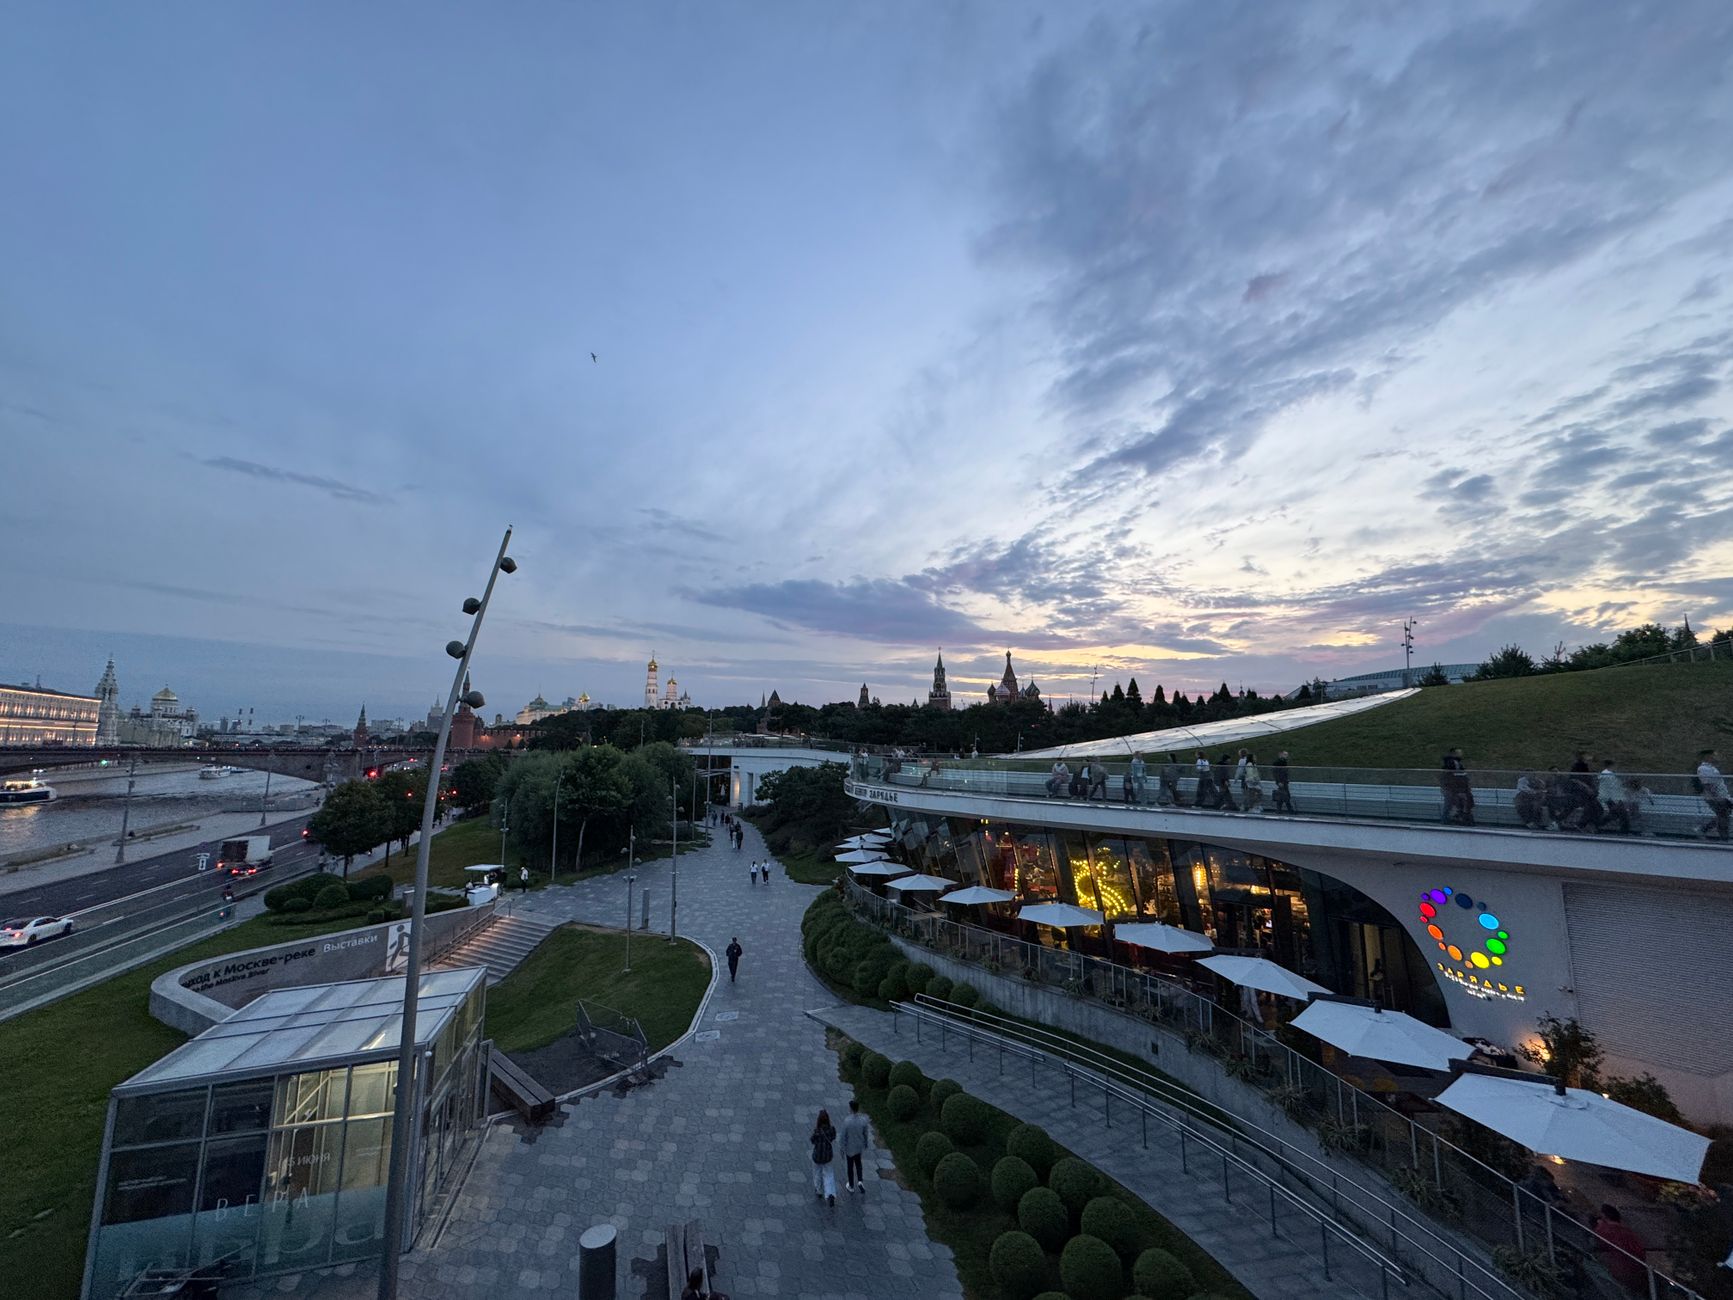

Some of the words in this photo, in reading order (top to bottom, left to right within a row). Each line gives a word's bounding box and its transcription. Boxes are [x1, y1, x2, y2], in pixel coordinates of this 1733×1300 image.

[322, 934, 378, 953] Выставки
[224, 948, 316, 976] Москве-реке
[1437, 962, 1525, 994] ЗАРЯДЬЕ
[215, 1186, 309, 1223] ВЕРА
